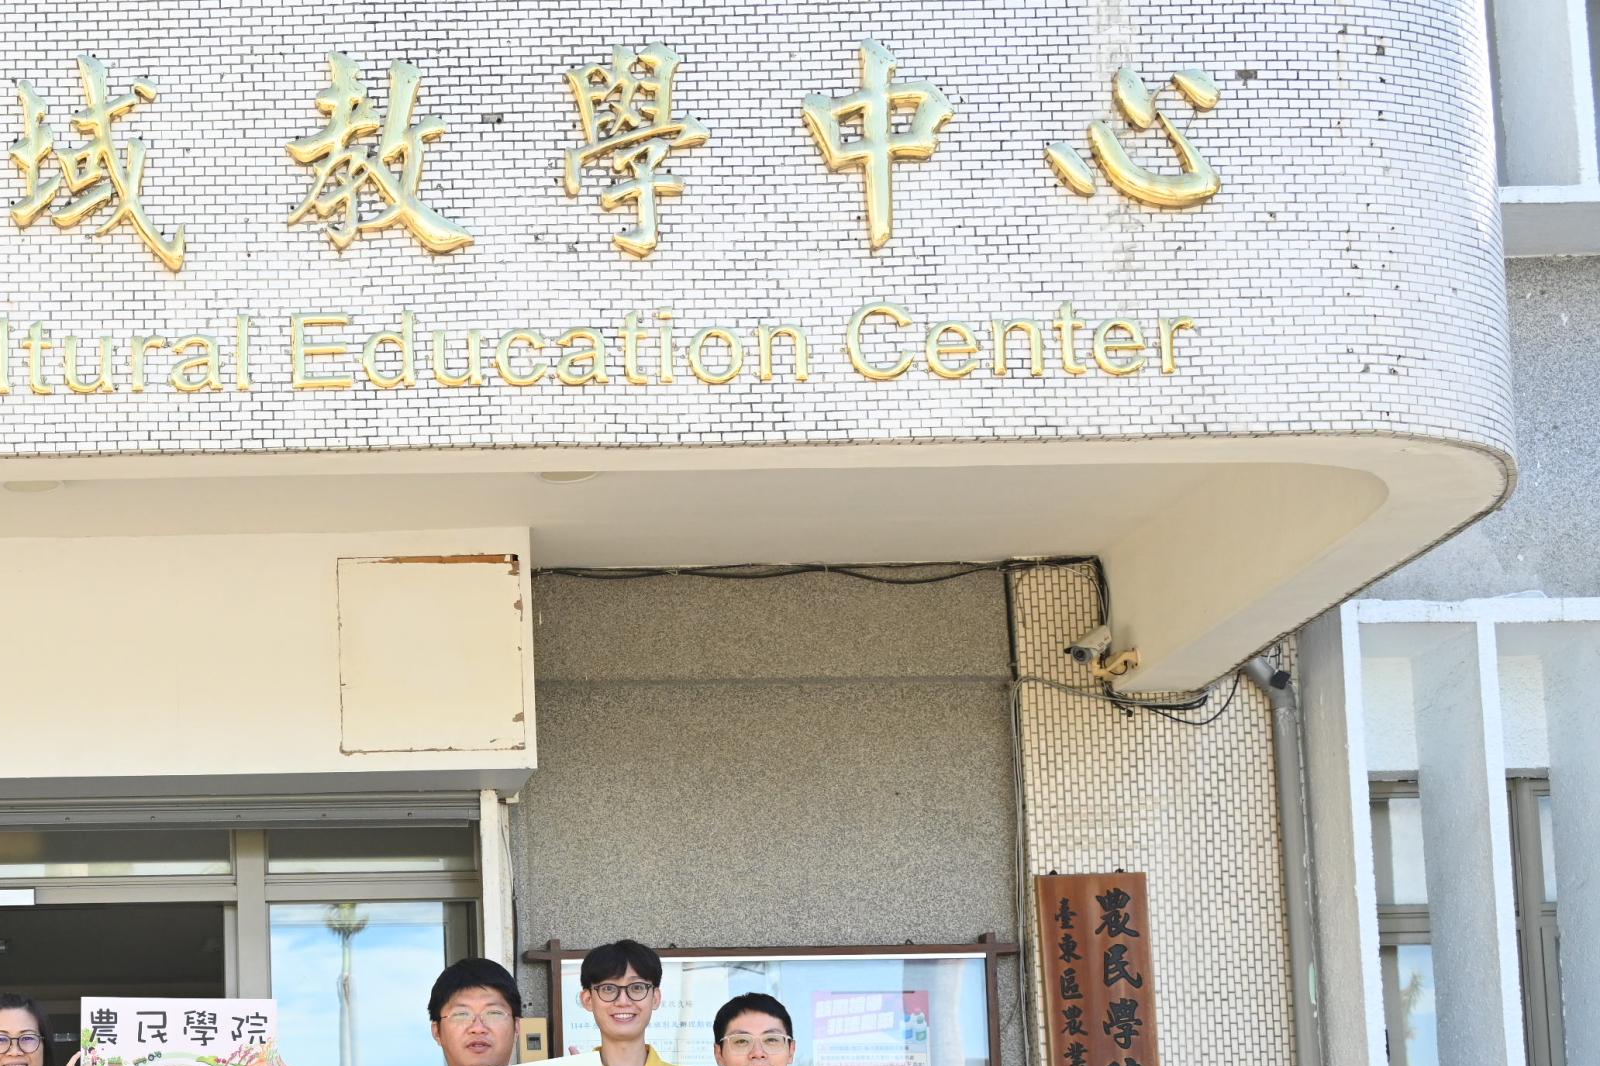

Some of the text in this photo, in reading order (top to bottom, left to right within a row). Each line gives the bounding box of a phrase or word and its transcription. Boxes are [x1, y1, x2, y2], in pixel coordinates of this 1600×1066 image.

[291, 308, 810, 389] Education
[846, 300, 1196, 381] Center
[88, 1008, 269, 1047] 農民學院
